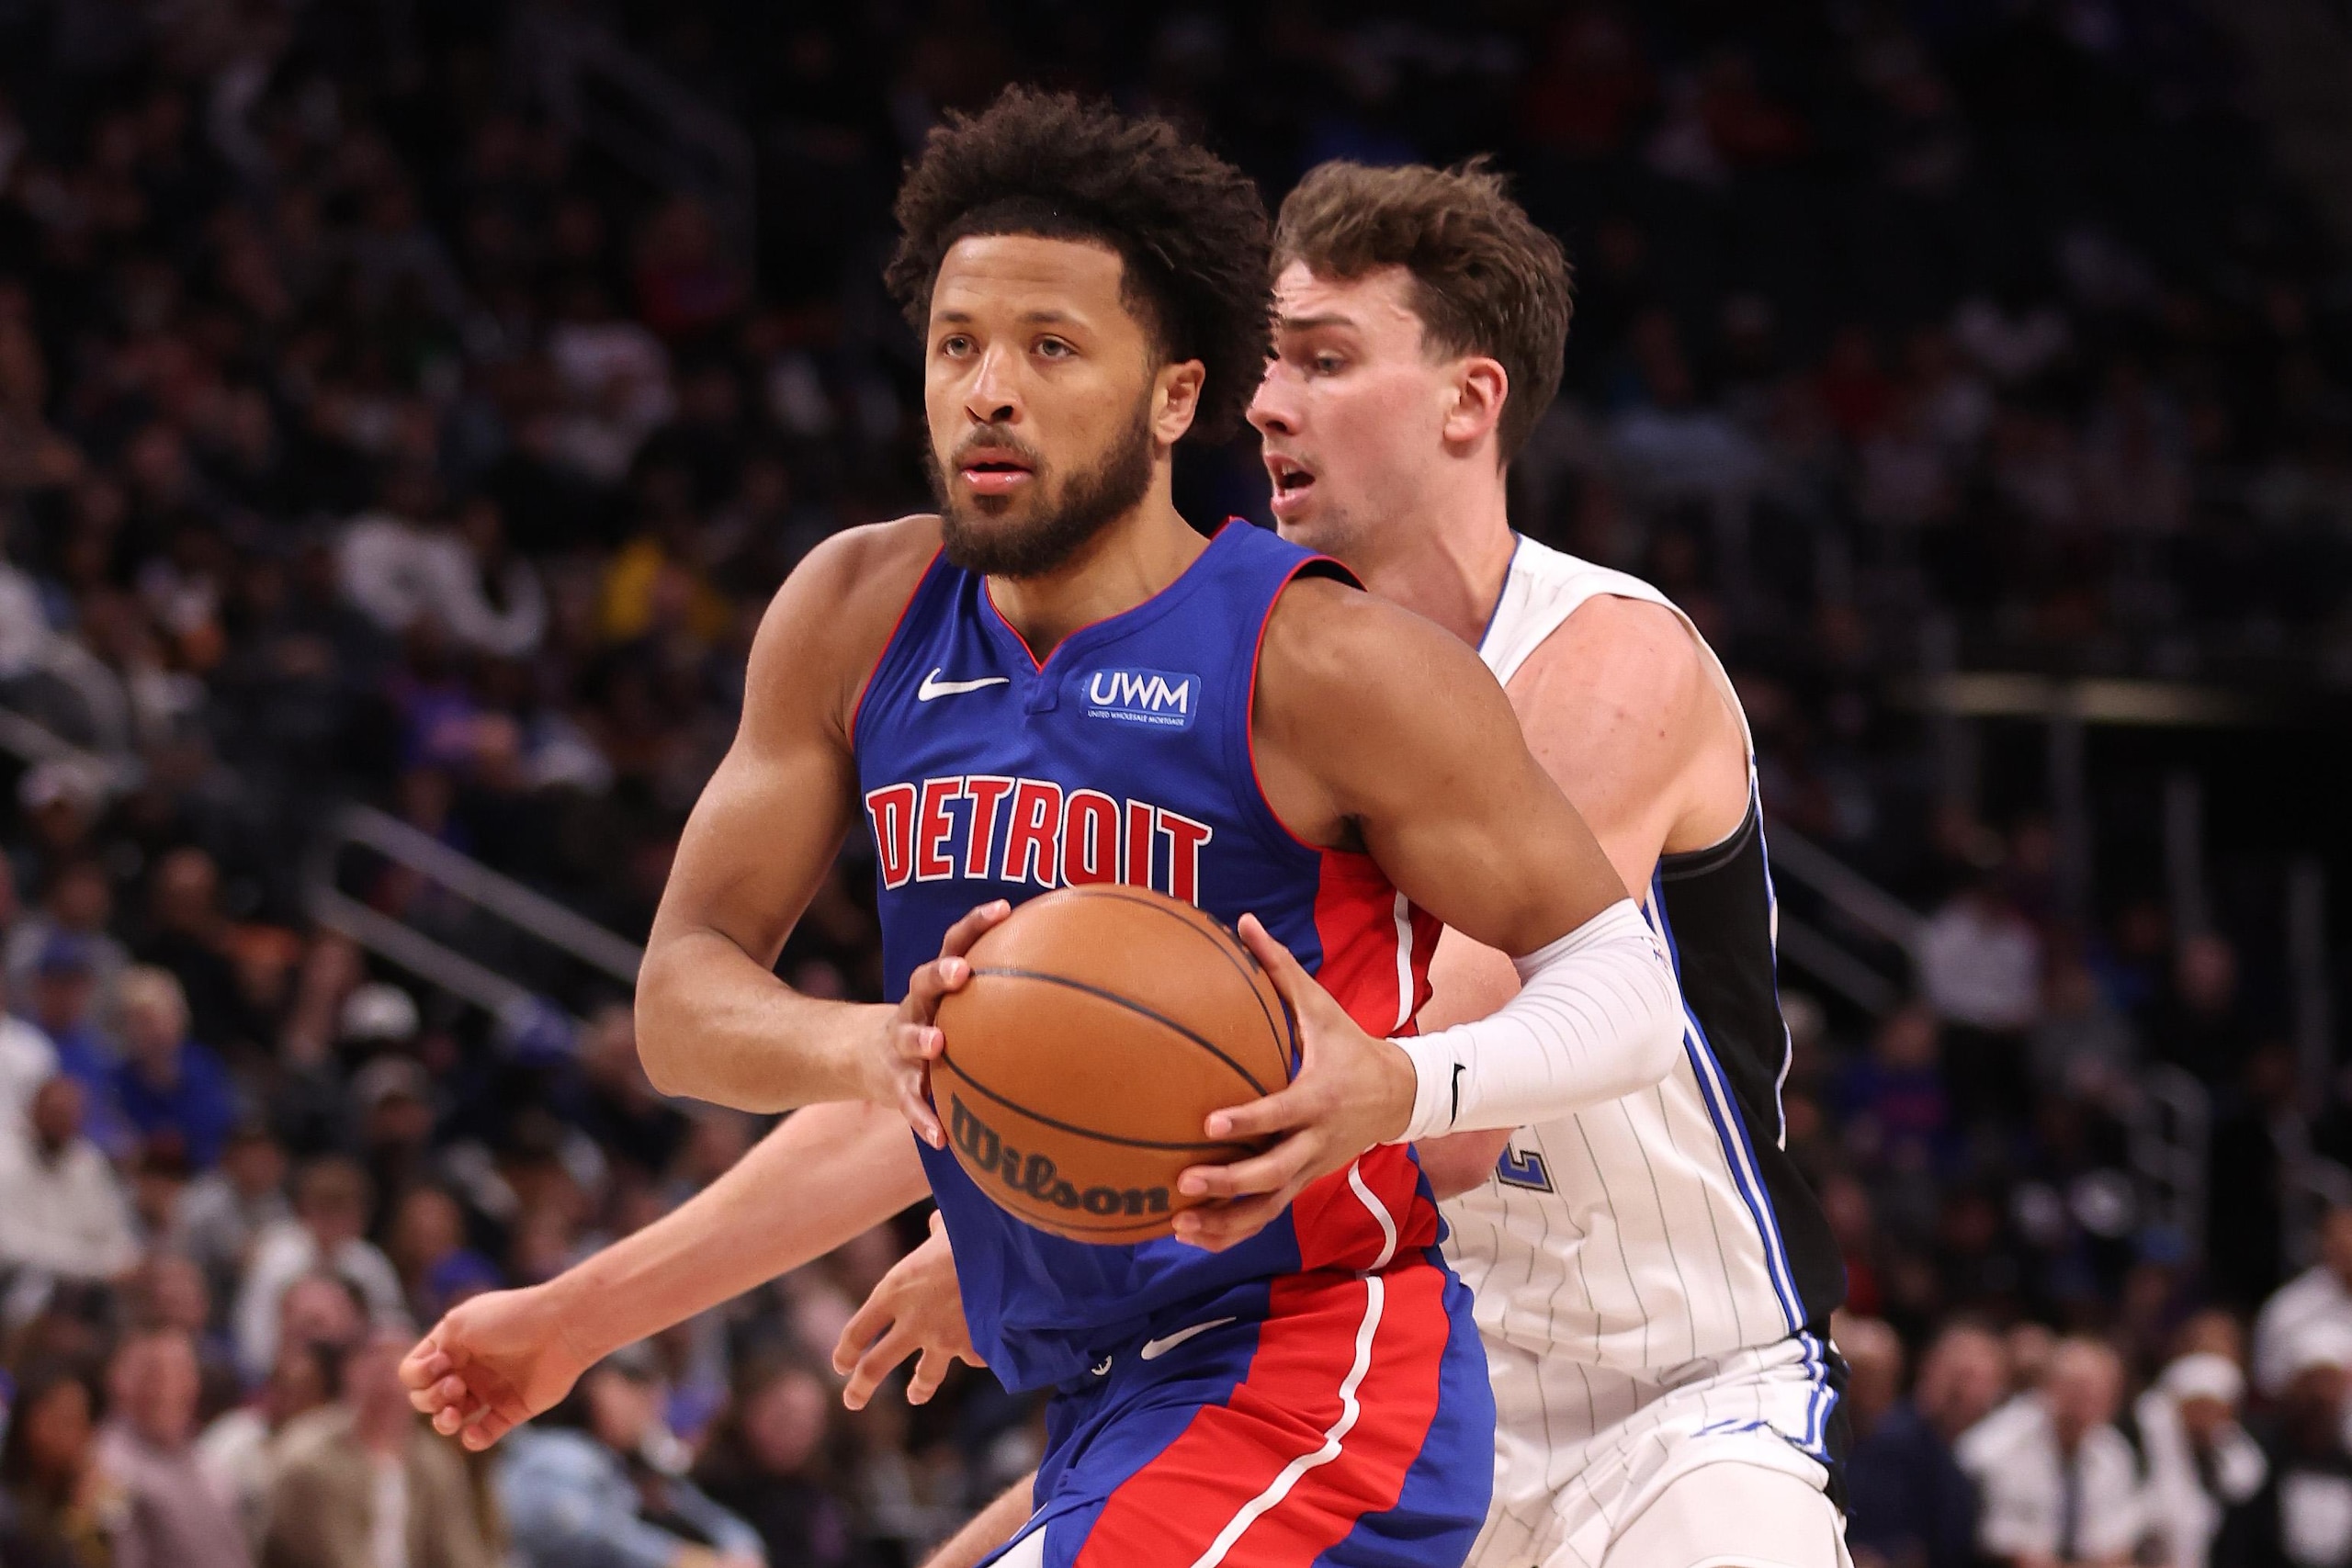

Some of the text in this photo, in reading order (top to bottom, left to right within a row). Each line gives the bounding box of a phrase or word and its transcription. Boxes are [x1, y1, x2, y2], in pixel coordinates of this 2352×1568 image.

[1087, 710, 1185, 727] UNITED WHOLESALE MORTGAGE
[1090, 671, 1190, 714] UWM
[865, 775, 1213, 908] DETROIT
[951, 1091, 1170, 1216] Wilson
